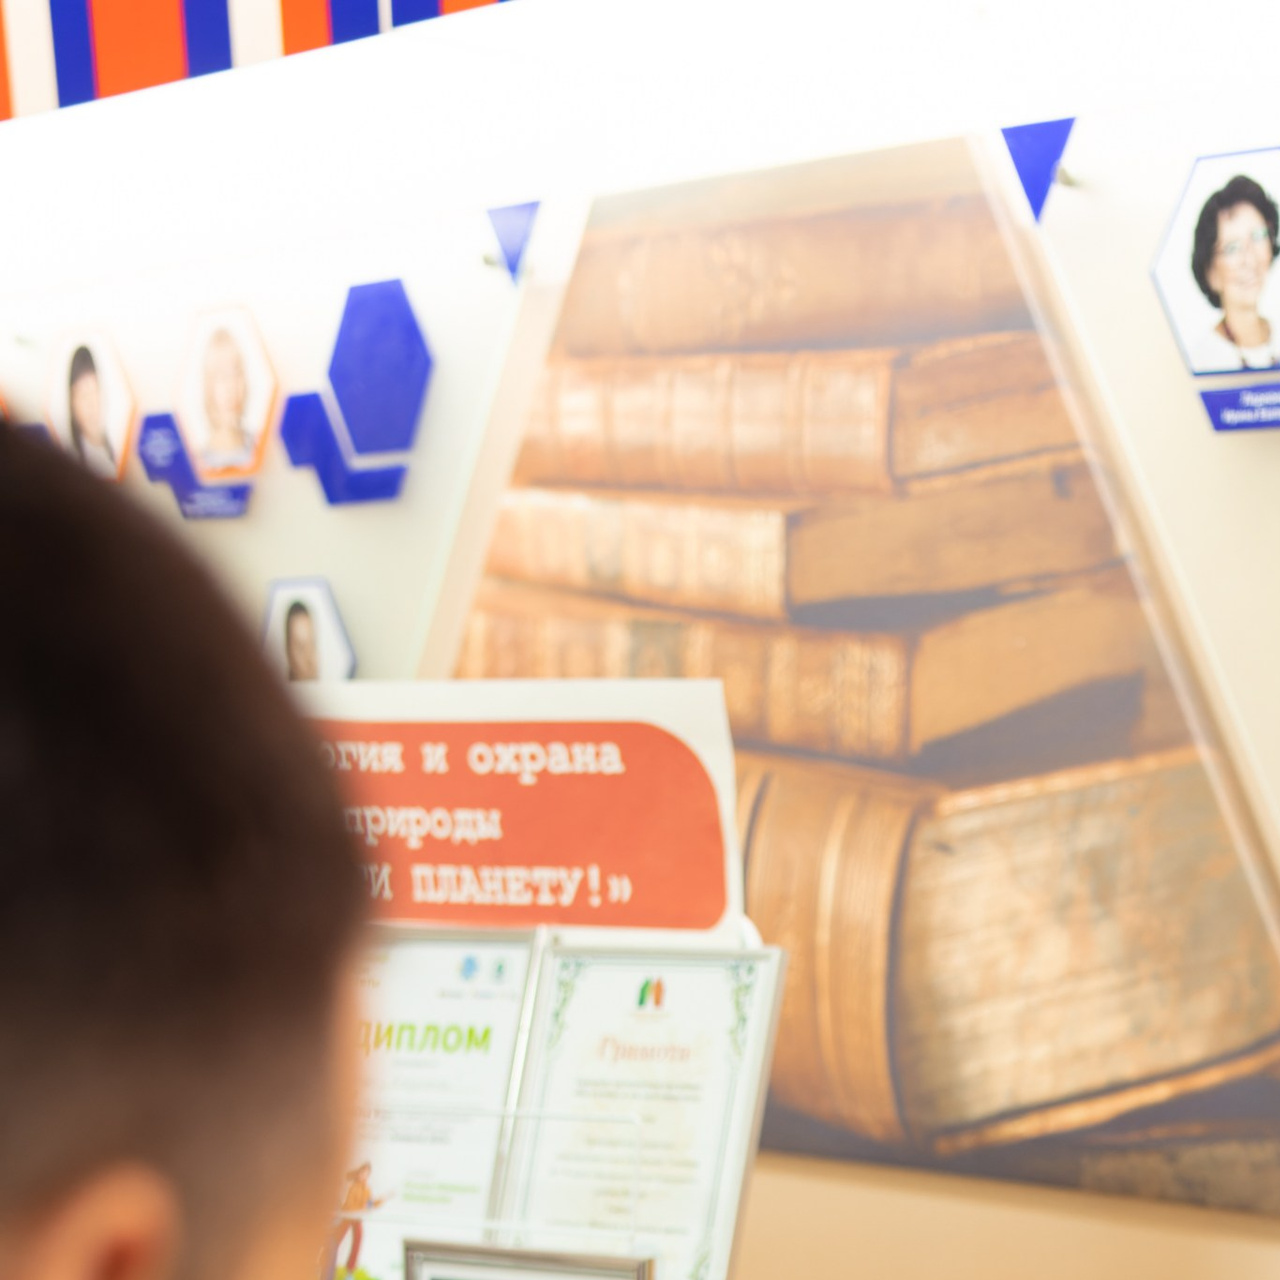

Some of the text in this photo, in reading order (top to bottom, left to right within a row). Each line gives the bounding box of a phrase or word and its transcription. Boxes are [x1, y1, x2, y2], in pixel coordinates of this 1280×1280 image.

[420, 742, 448, 773] и
[467, 741, 625, 785] охрана
[343, 806, 502, 849] природы
[409, 863, 633, 907] ПЛАНЕТУ!»
